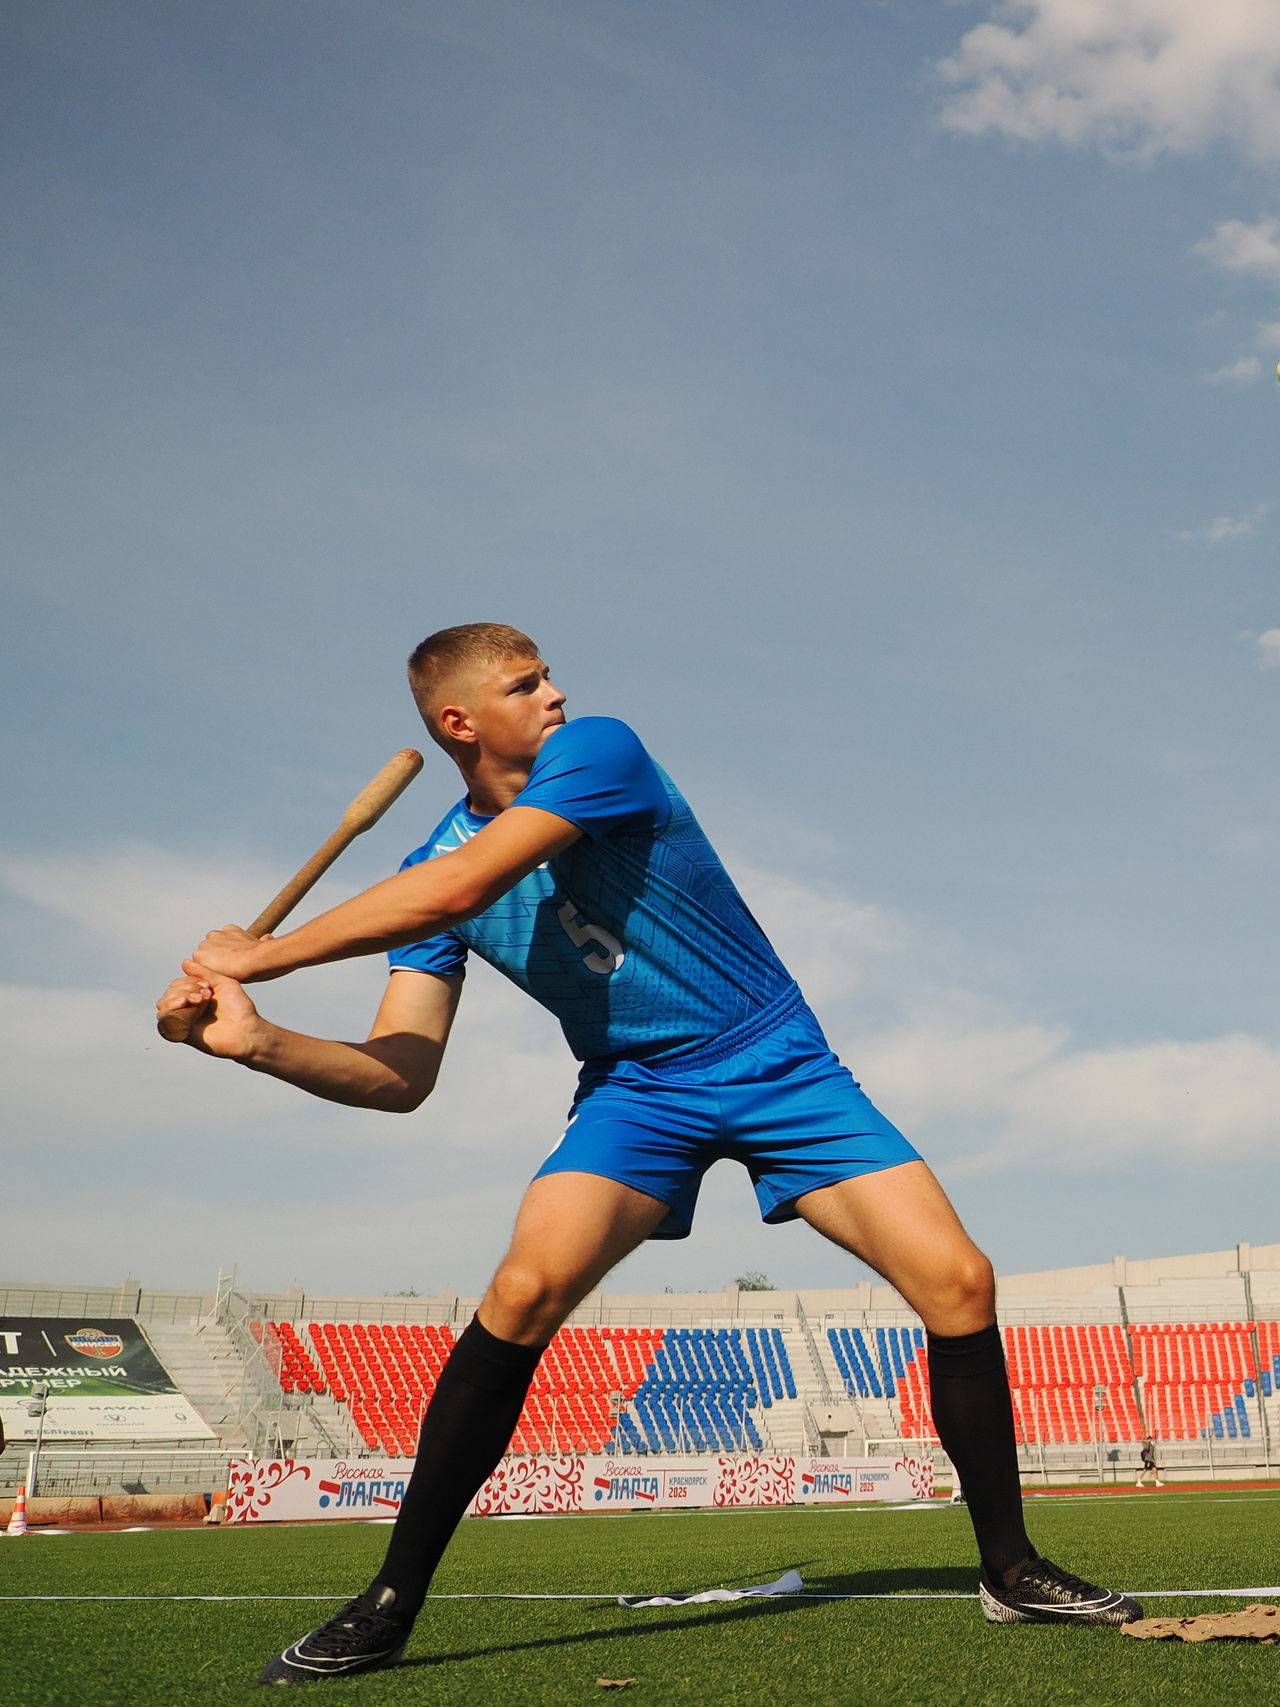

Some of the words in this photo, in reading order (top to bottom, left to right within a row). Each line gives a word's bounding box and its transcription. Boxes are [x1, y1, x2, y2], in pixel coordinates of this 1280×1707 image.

[556, 899, 625, 975] 5
[0, 1332, 22, 1354] Т
[0, 1379, 82, 1388] РТНЕР
[331, 1461, 385, 1479] Русская
[603, 1460, 643, 1476] Русская
[808, 1459, 840, 1473] Русская
[669, 1476, 708, 1486] КРАСНОЯРСК
[812, 1474, 852, 1494] ЛАПТА
[860, 1473, 890, 1481] КРАСНОЯРСК
[335, 1481, 405, 1507] ЛАПТА
[607, 1477, 658, 1500] ЛАПТА
[668, 1487, 687, 1498] 2025
[860, 1482, 874, 1492] 2025
